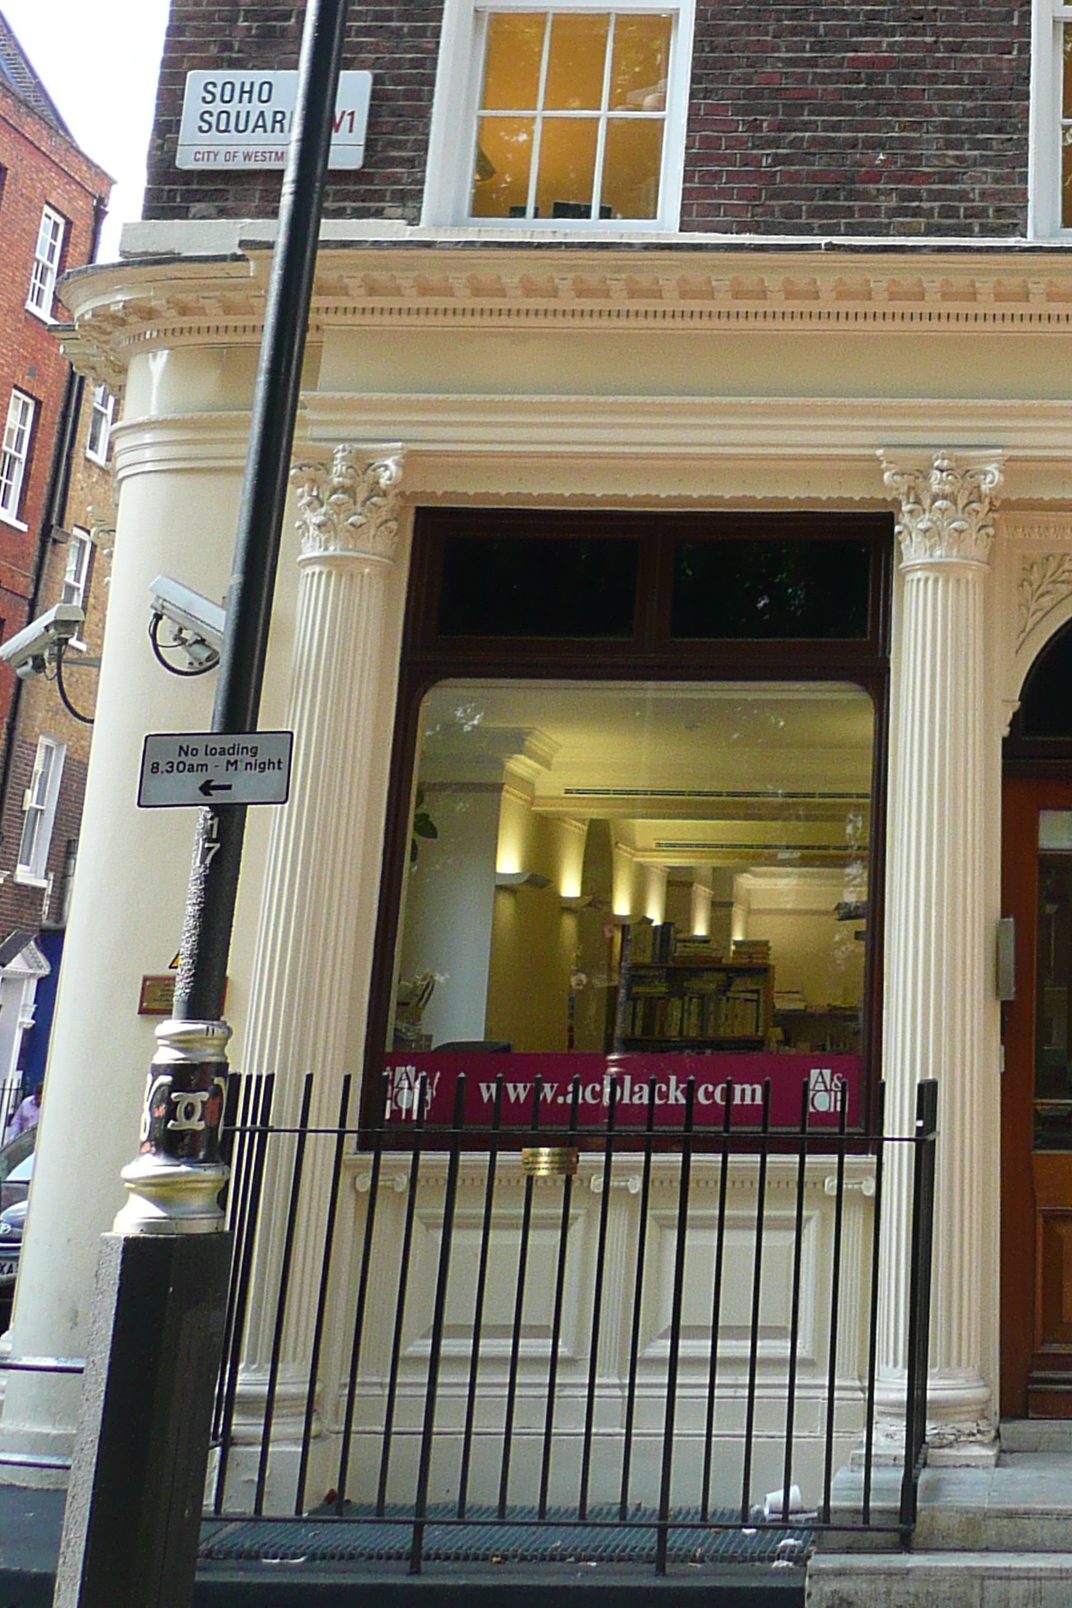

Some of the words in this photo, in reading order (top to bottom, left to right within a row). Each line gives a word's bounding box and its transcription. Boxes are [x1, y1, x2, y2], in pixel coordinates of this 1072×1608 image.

[202, 80, 274, 105] SOHO
[197, 110, 293, 134] SQUAR
[193, 150, 220, 163] CITY
[223, 150, 238, 163] OF
[242, 150, 285, 163] WESTM
[177, 744, 199, 758] No
[204, 743, 259, 759] loading
[150, 760, 209, 775] 8.30am
[478, 1075, 764, 1105] www.acblackcom
